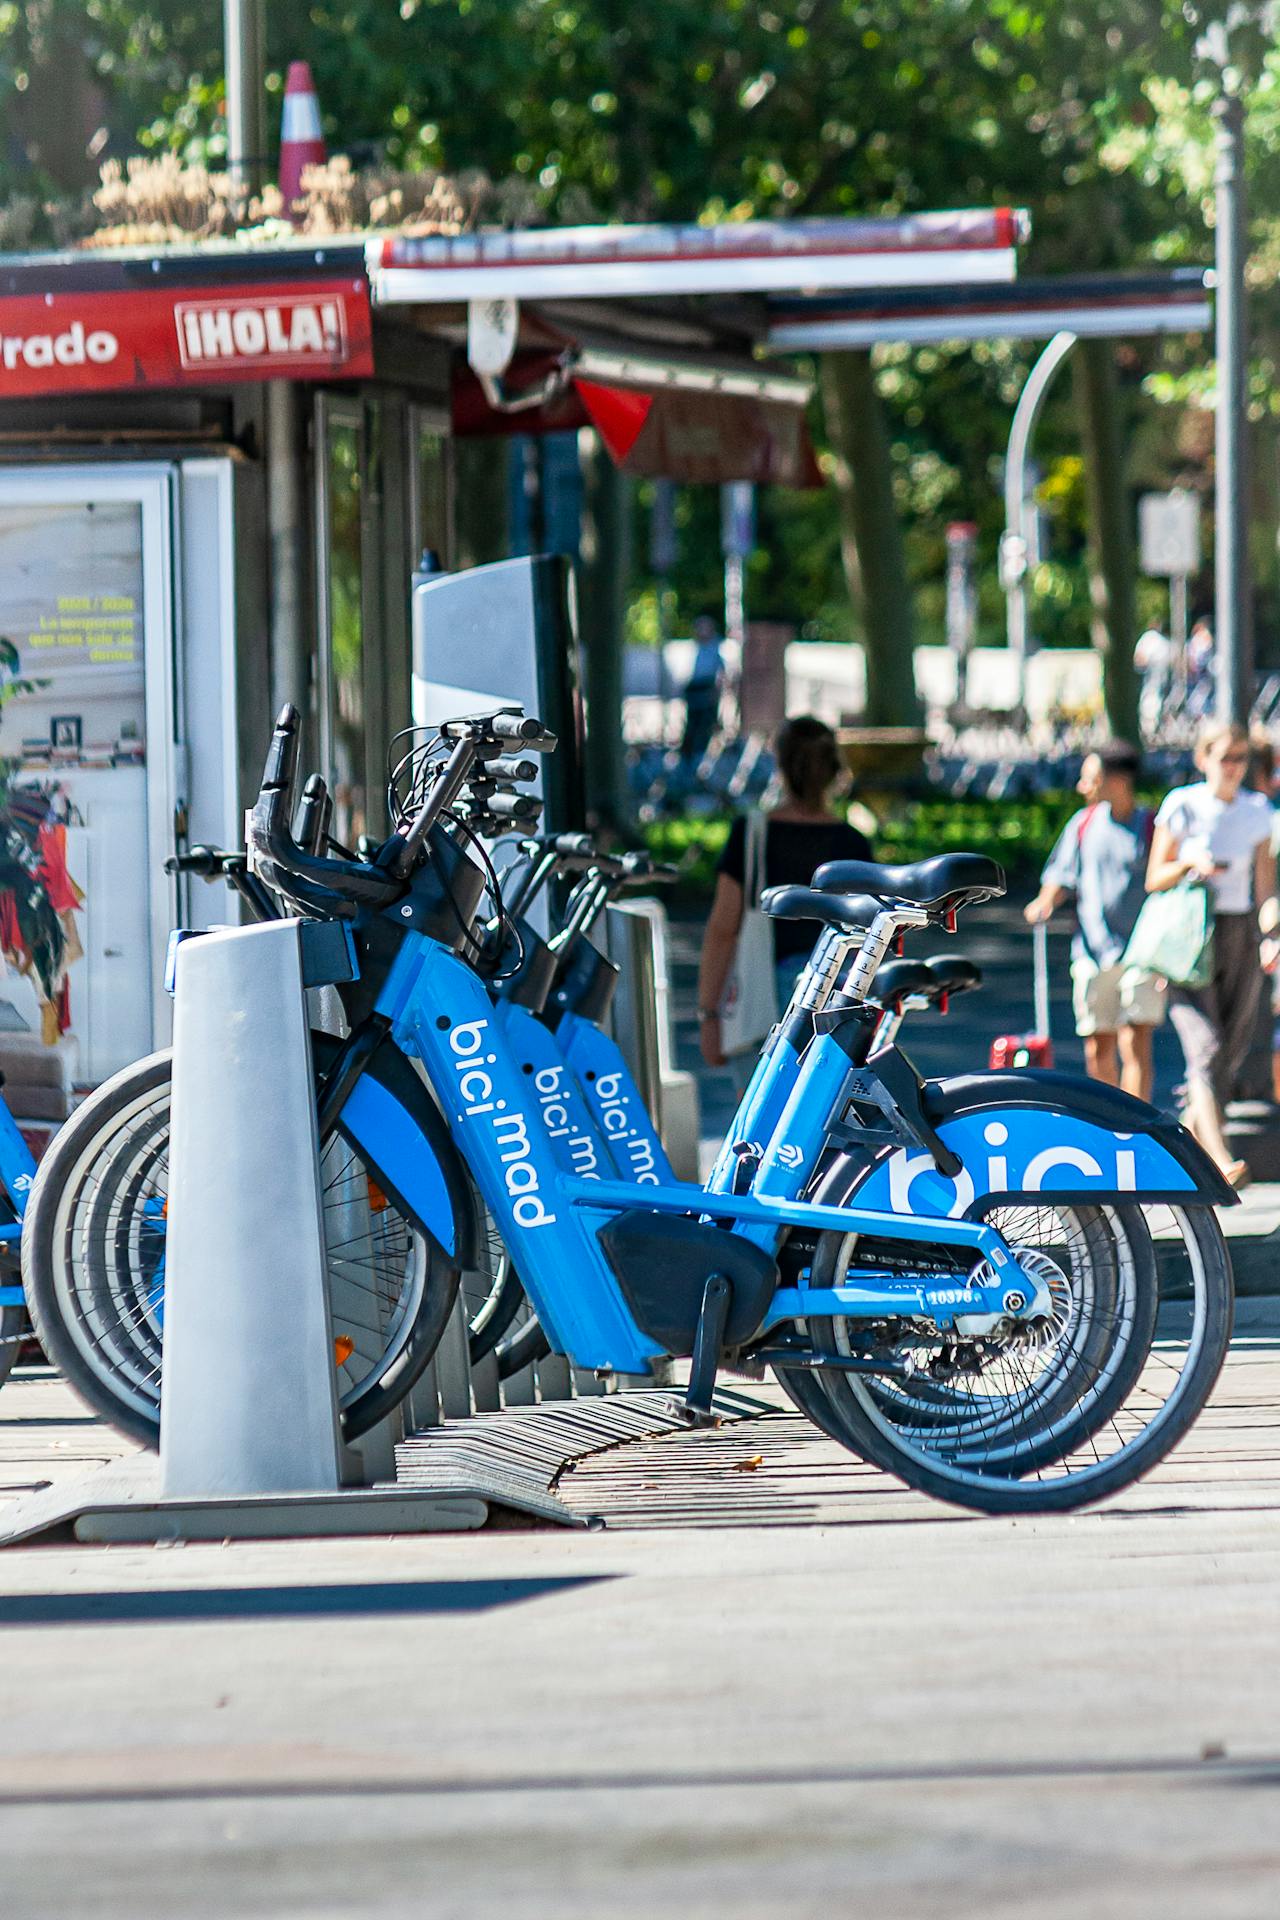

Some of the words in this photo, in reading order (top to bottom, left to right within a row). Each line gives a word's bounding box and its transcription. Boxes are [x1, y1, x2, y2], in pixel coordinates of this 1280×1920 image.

[0, 320, 119, 369] rado
[183, 302, 341, 360] ¡HOLA!
[861, 962, 868, 970] 3
[535, 1065, 601, 1180] bicim
